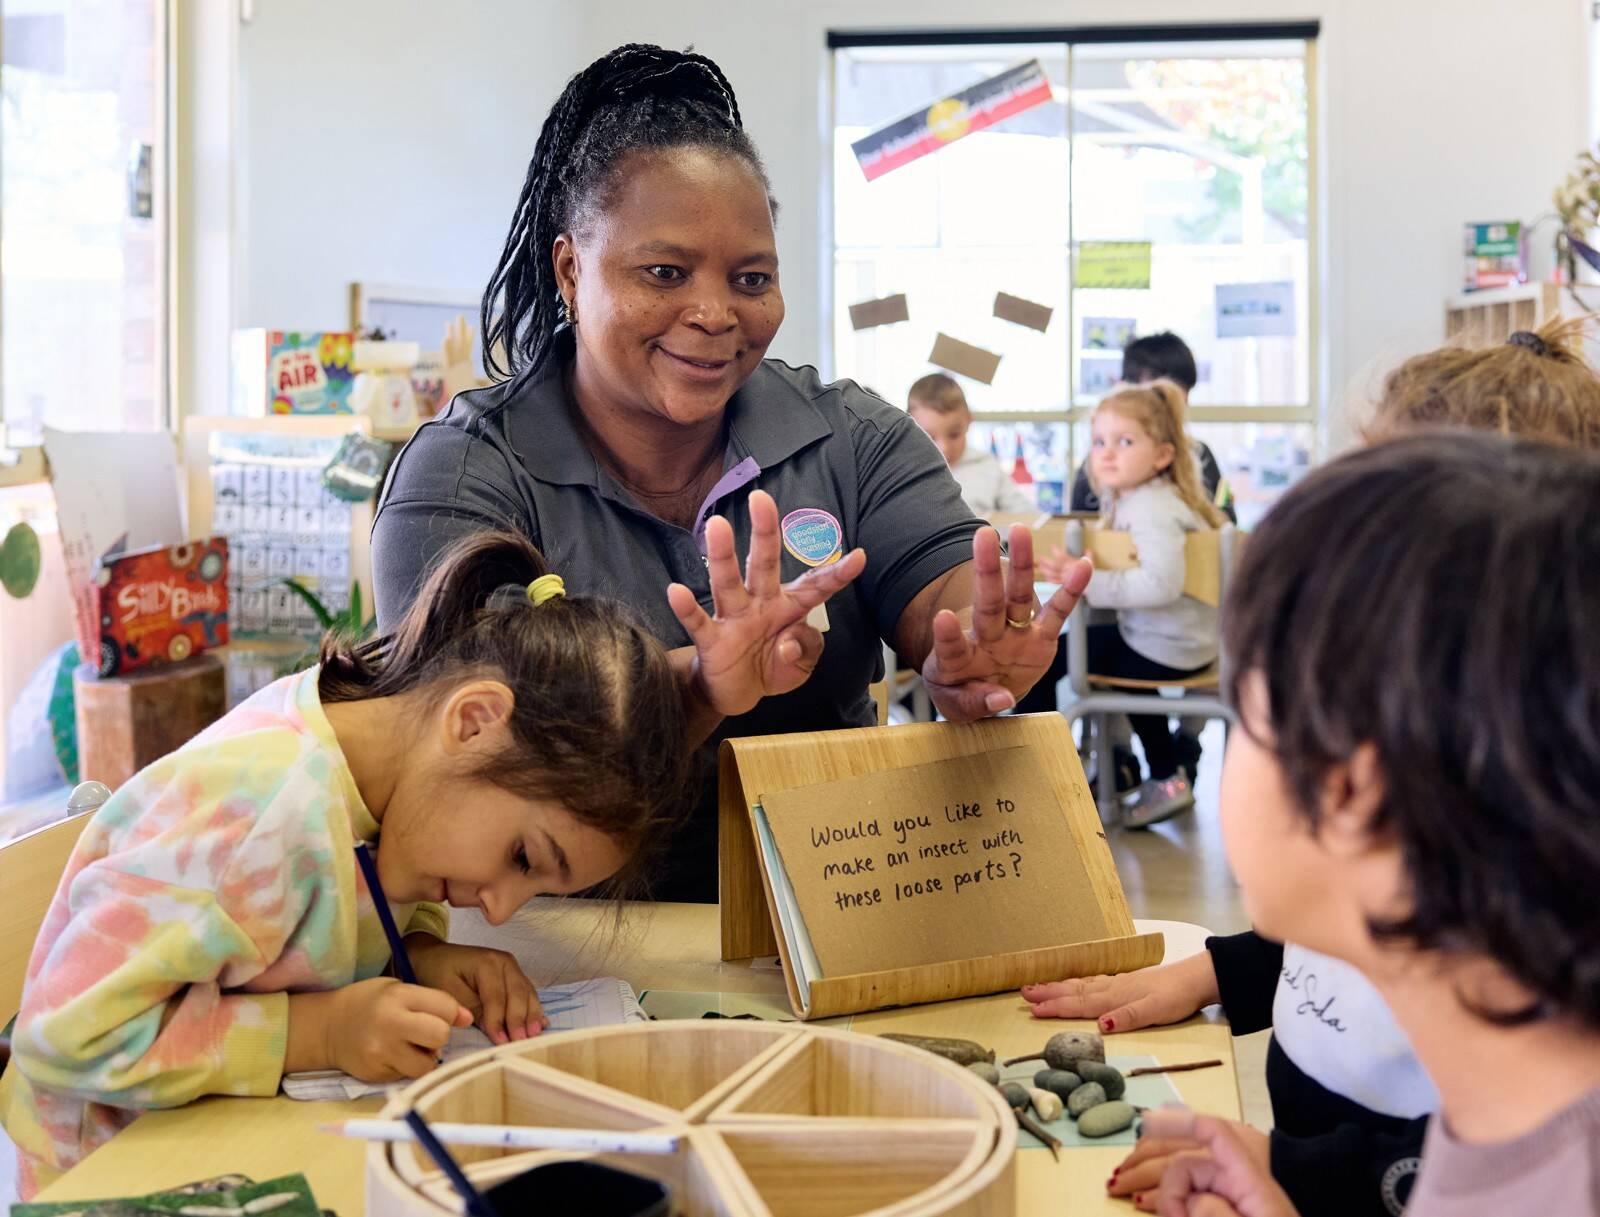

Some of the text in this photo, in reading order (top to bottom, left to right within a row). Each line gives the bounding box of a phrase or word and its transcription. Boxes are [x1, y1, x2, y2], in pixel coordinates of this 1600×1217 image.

[279, 364, 317, 391] AIR
[810, 819, 882, 848] Would
[894, 814, 932, 844] you
[996, 798, 1016, 814] to
[823, 829, 1024, 880] make an insect with
[834, 852, 1023, 911] these loose parts?
